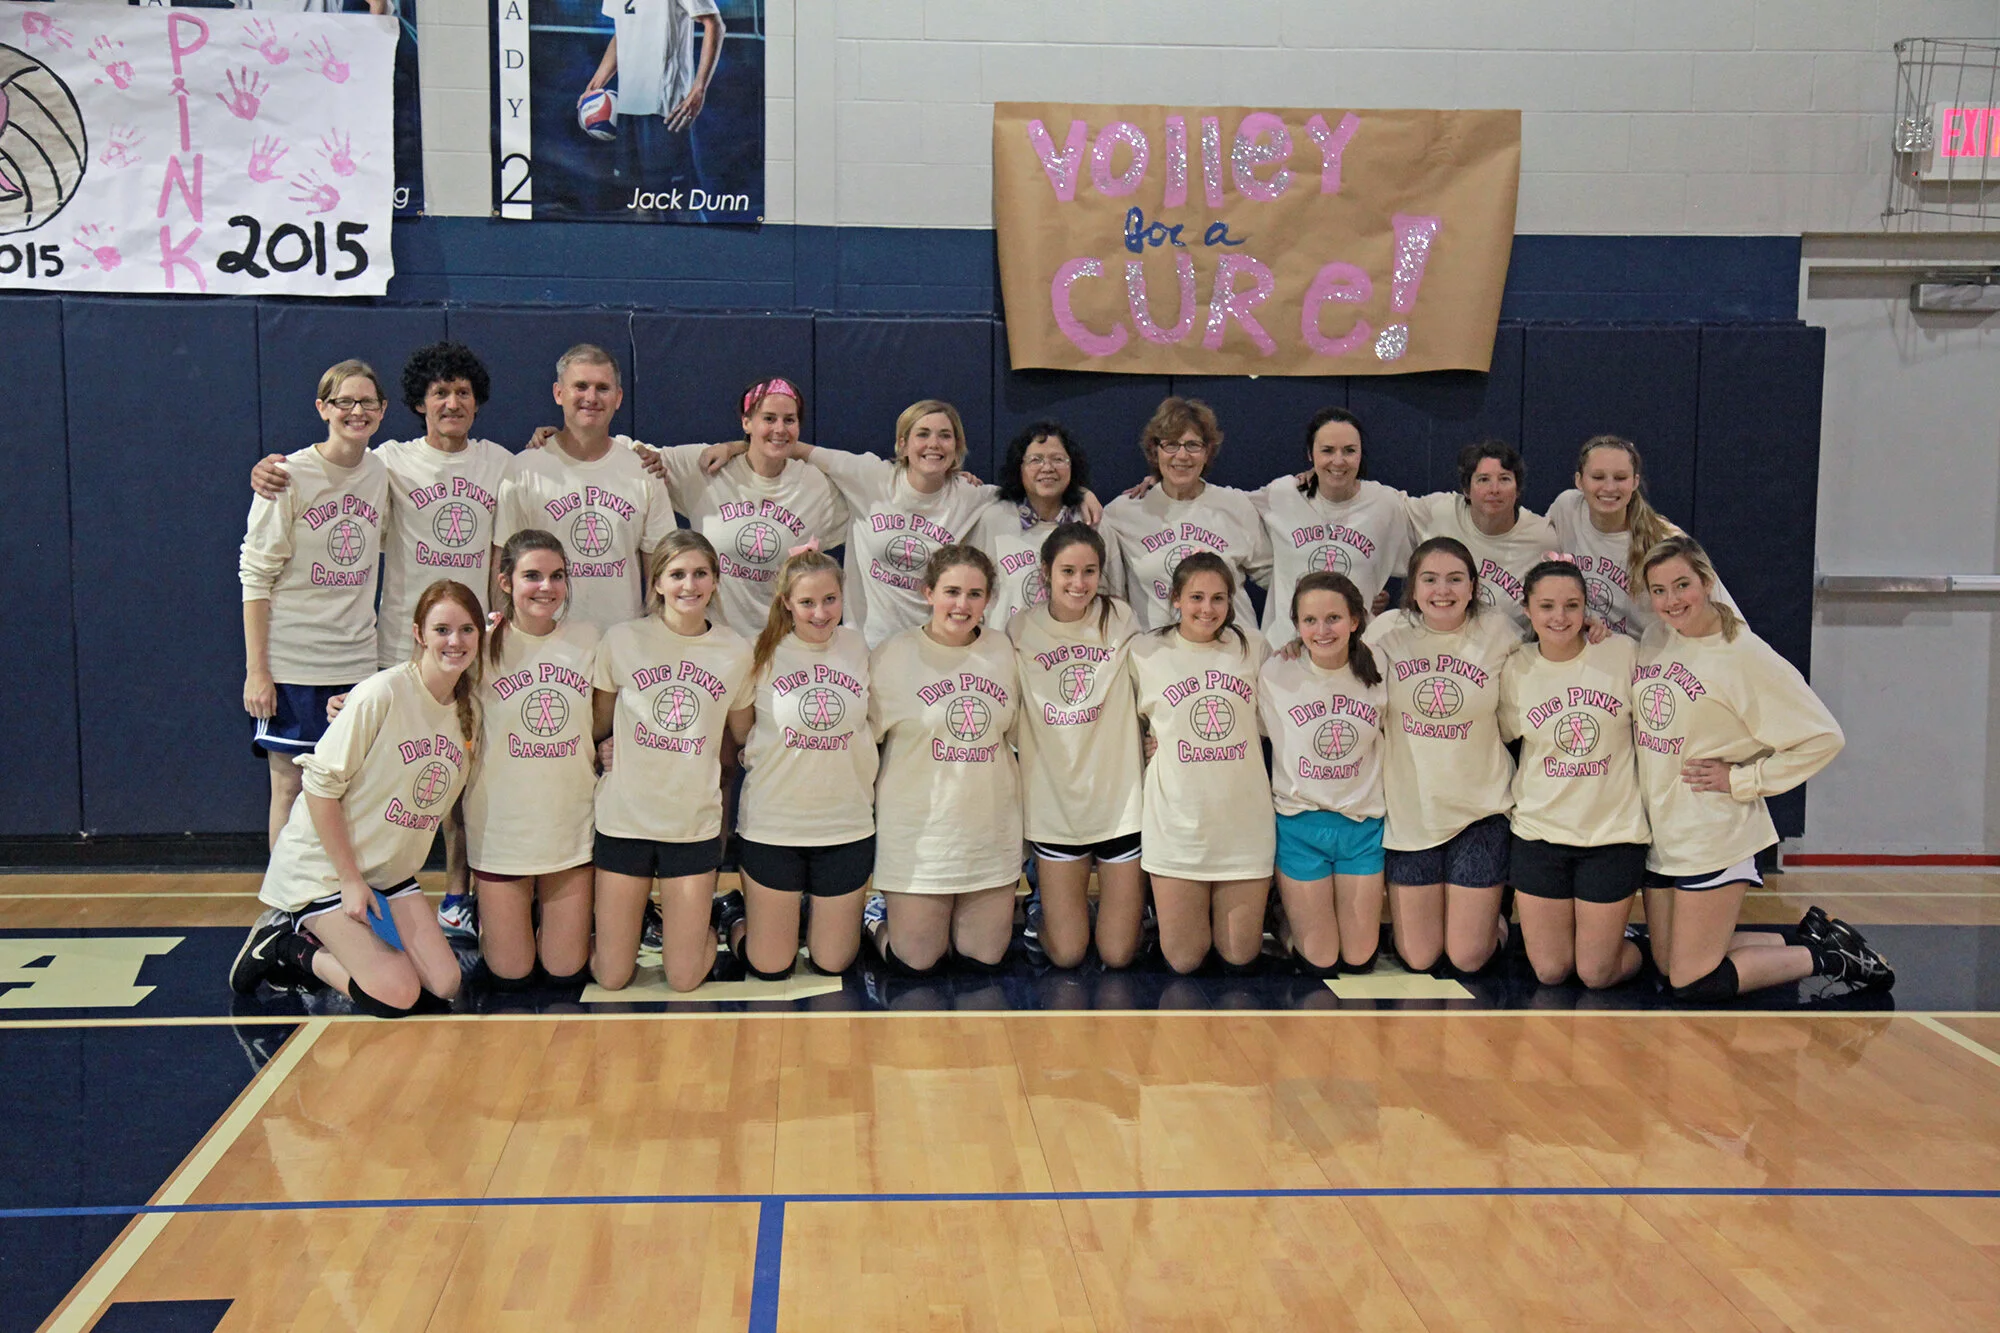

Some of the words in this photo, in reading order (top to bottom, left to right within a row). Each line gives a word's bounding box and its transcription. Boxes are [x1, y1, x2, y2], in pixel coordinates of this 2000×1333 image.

[627, 188, 684, 209] Jack
[688, 189, 750, 211] Dunn
[1123, 206, 1186, 253] for
[1203, 220, 1245, 247] a
[216, 215, 369, 281] 2015
[303, 500, 338, 531] DIG
[342, 494, 379, 528] PINK
[409, 483, 447, 510] DIG
[453, 477, 497, 514] PINK
[545, 492, 581, 521] DIG
[585, 485, 637, 521] PINK
[719, 500, 755, 522] DIG
[760, 499, 805, 537] PINK
[871, 513, 905, 533] DIG
[909, 514, 955, 545] PINK
[416, 541, 485, 568] CASADY
[1141, 522, 1175, 553] DIG
[1180, 522, 1229, 552] PINK
[1291, 525, 1324, 548] DIG
[1328, 525, 1376, 559] PINK
[311, 562, 372, 586] CASADY
[566, 557, 627, 577] ASADY
[1000, 549, 1035, 575] DIG
[1596, 556, 1631, 595] PIN
[1479, 558, 1524, 601] PINK
[492, 669, 534, 700] DIG
[538, 663, 590, 697] PINK
[632, 664, 672, 691] DIG
[678, 660, 727, 701] PINK
[773, 670, 809, 697] DIG
[814, 664, 863, 697] PINK
[1163, 676, 1200, 706] DIG
[1205, 670, 1253, 703] PINK
[1395, 658, 1431, 682] DIG
[1436, 654, 1489, 689] PINK
[1663, 661, 1706, 702] PINK
[917, 679, 955, 707] DIG
[960, 673, 1008, 707] PINK
[1288, 700, 1326, 727] DIG
[1332, 694, 1378, 727] PINK
[1526, 696, 1564, 729] DIG
[1567, 687, 1623, 717] PINK
[634, 721, 707, 755] CASADY
[785, 726, 854, 750] CASADY
[1401, 712, 1473, 739] CASADY
[398, 738, 431, 765] DIG
[434, 734, 463, 772] PIN
[508, 733, 580, 758] CASADY
[932, 737, 999, 762] CASADY
[1178, 739, 1248, 762] CASADY
[1299, 756, 1363, 779] CASADY
[1543, 754, 1611, 777] CASADY
